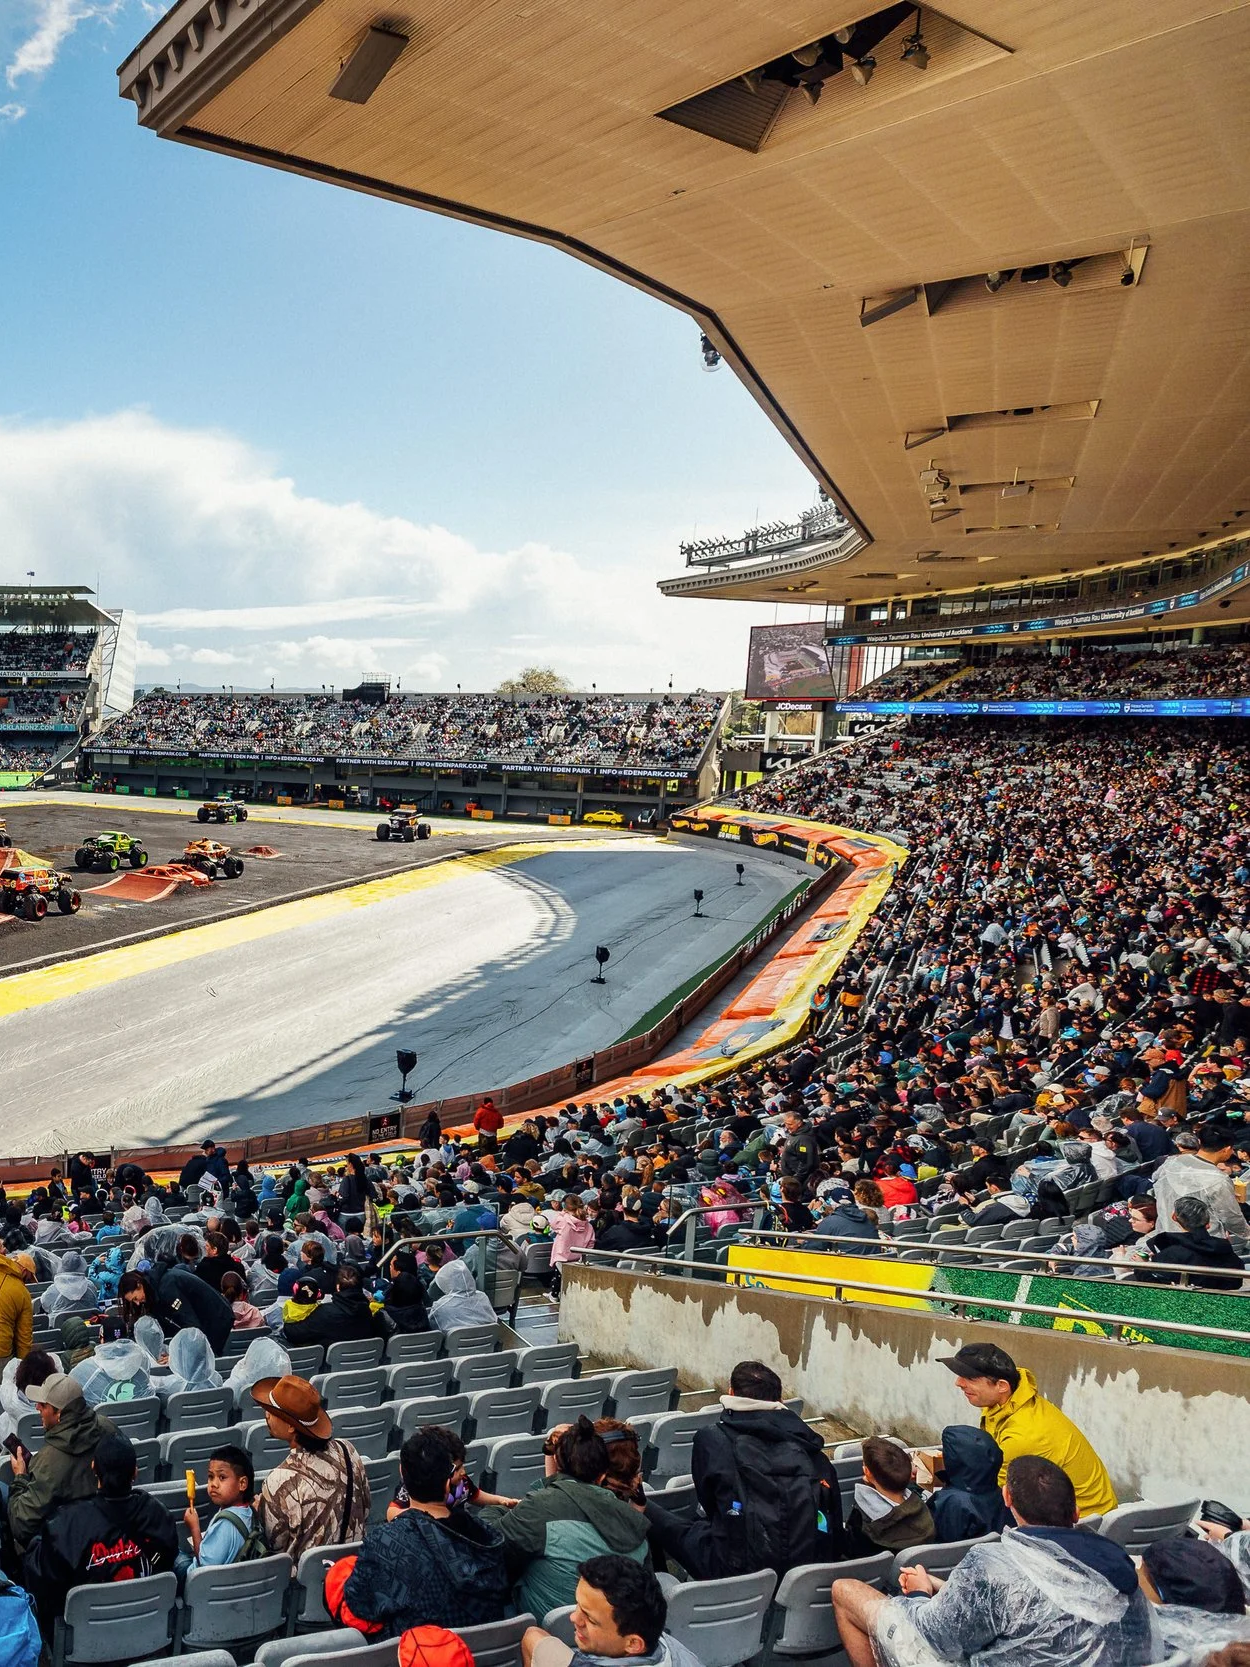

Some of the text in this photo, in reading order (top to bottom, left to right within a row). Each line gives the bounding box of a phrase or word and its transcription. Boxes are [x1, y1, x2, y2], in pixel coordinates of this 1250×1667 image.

[1054, 618, 1072, 627] Waipapa
[1073, 616, 1091, 624] Taumata
[1100, 610, 1125, 620] University
[866, 635, 888, 643] Waipapa
[921, 631, 945, 640] University
[951, 628, 973, 636] Auckland
[776, 702, 812, 710] JCDecaux
[502, 764, 532, 772] PARTNER
[533, 765, 551, 773] WITH
[552, 766, 571, 774] EDEN
[572, 766, 591, 774] PARK
[380, 1124, 398, 1133] ENTRY
